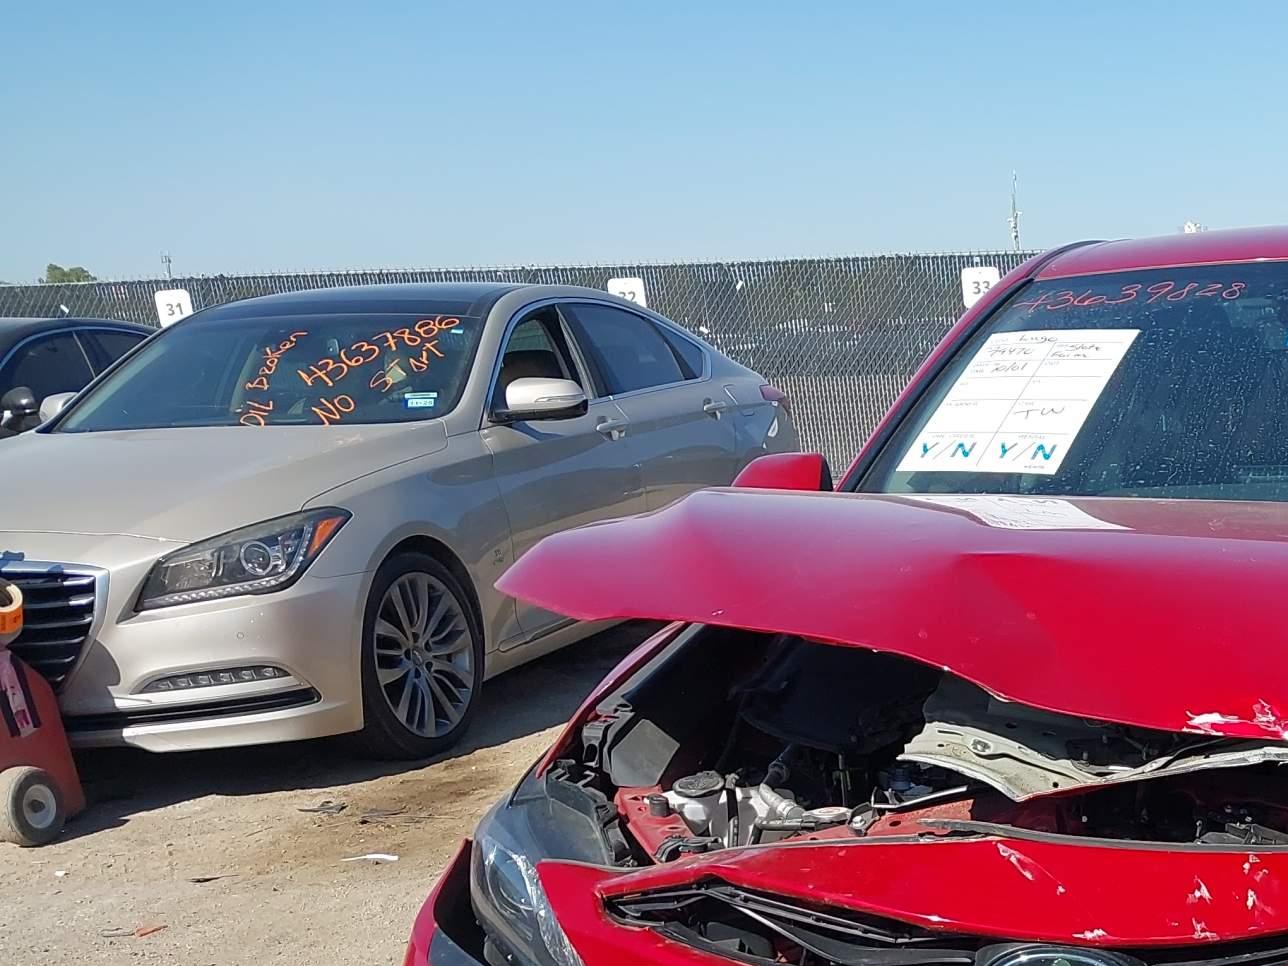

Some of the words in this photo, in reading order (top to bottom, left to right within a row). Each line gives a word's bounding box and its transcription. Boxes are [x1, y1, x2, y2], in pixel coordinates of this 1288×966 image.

[165, 302, 184, 317] 31
[297, 315, 460, 387] 43637886
[311, 394, 355, 427] NO
